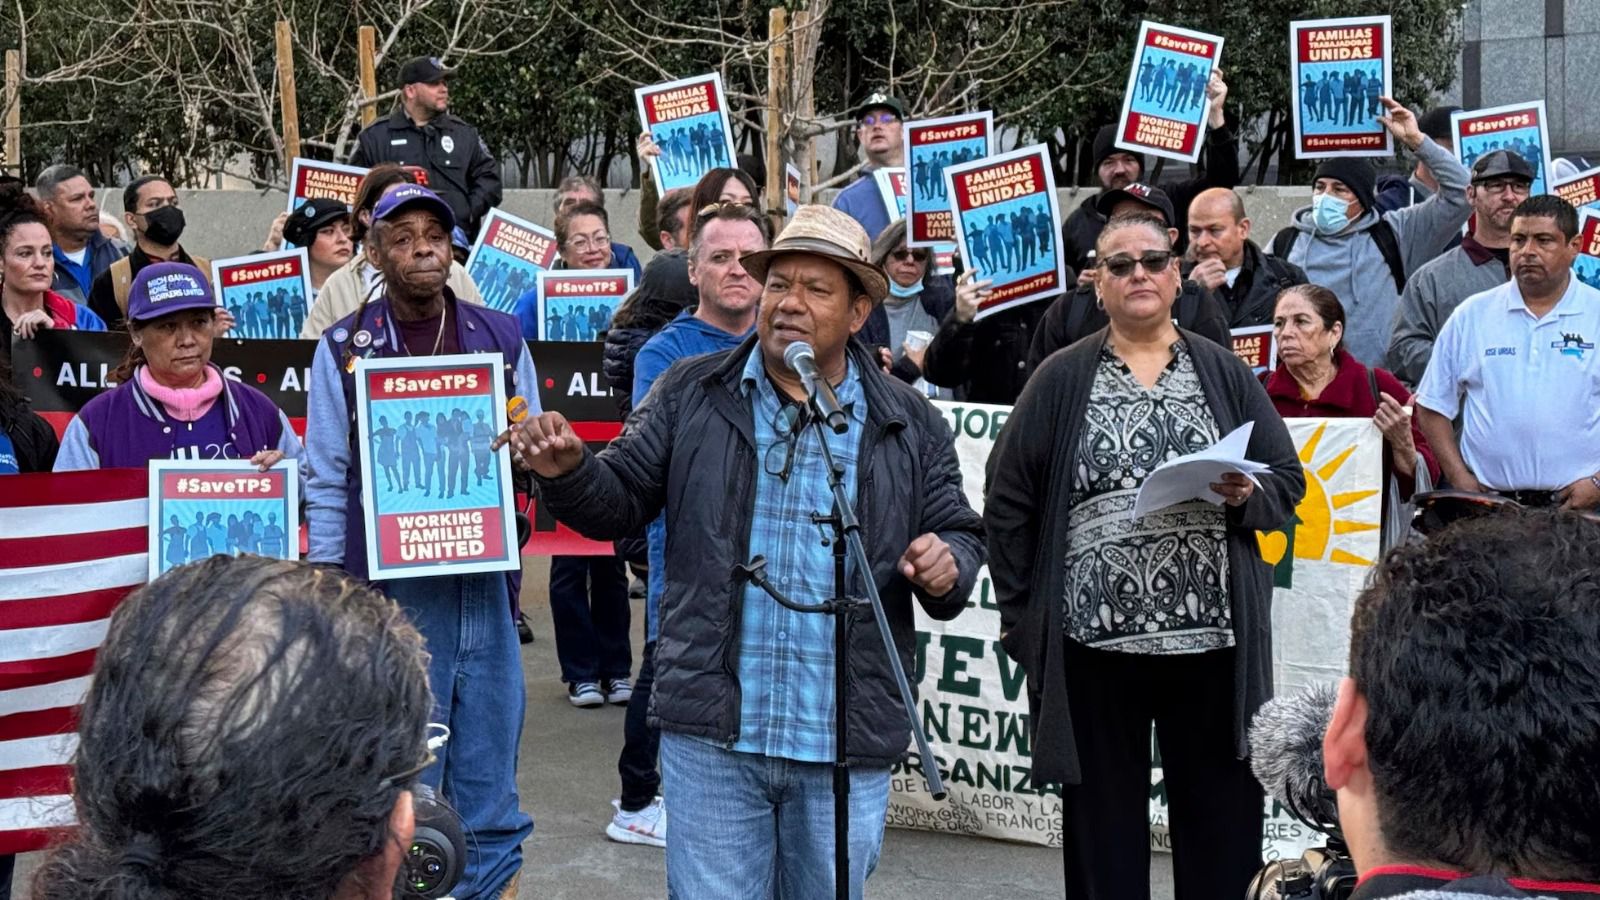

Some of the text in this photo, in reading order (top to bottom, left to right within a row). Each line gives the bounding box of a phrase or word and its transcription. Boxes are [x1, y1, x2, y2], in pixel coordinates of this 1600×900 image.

[1308, 28, 1372, 42] FAMILIAS
[1308, 39, 1372, 48] TRABAJADORAS
[1154, 35, 1208, 54] #SaveTPS
[1308, 46, 1372, 60] UNIDAS
[652, 86, 707, 104] FAMILIAS
[655, 101, 710, 121] UNIDAS
[1138, 123, 1186, 140] FAMILIES
[1140, 115, 1187, 131] WORKING
[1469, 114, 1530, 132] #SaveTPS
[920, 124, 978, 142] #SaveTPS
[1135, 132, 1184, 150] UNITED
[1307, 136, 1381, 146] #SalvemosTPS
[306, 170, 358, 186] FAMILIAS
[965, 160, 1032, 186] FAMILIAS
[967, 171, 1034, 194] TRABAJADORAS
[304, 186, 356, 204] UNIDAS
[968, 180, 1036, 207] UNIDAS
[498, 222, 550, 249] FAMILIAS
[492, 237, 544, 264] UNIDAS
[231, 263, 292, 282] #SaveTPS
[555, 282, 617, 293] #SaveTPS
[384, 374, 478, 393] #SaveTPS
[176, 478, 272, 494] #SaveTPS
[397, 512, 483, 528] WORKING
[400, 525, 484, 544] FAMILIES
[400, 540, 485, 560] UNITED
[923, 699, 1032, 757] NEW
[892, 778, 916, 792] DE
[961, 792, 1015, 811] LABOR
[1024, 800, 1034, 814] Y
